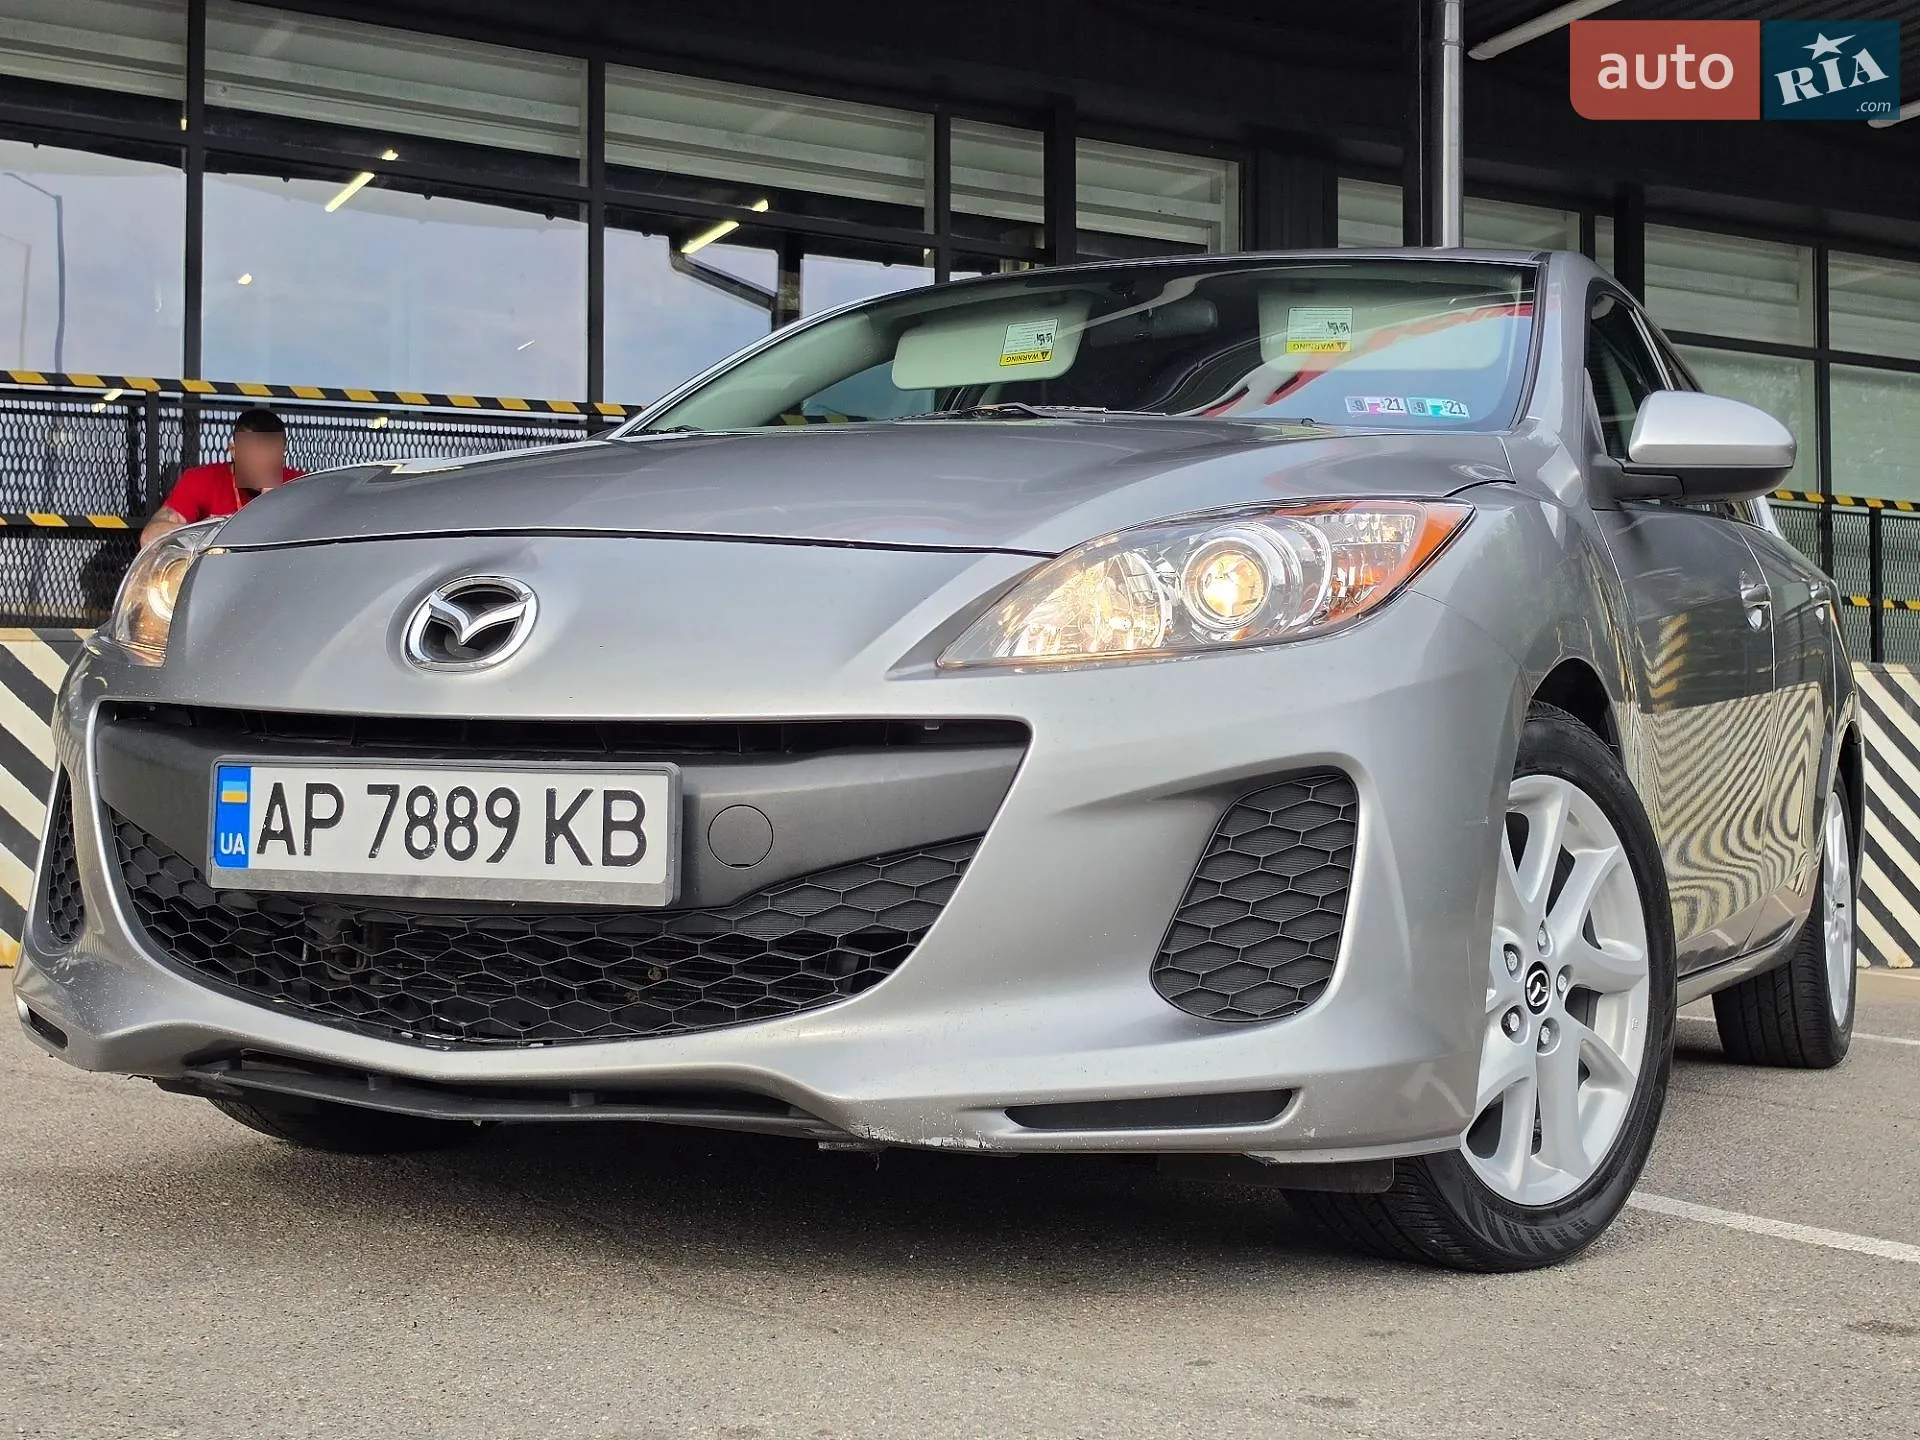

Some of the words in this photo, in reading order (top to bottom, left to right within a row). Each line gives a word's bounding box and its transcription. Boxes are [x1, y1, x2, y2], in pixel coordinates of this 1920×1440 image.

[1005, 353, 1039, 363] WARNING
[1384, 398, 1404, 411] 21
[1446, 400, 1466, 415] 21
[256, 782, 345, 857] AP
[366, 784, 521, 864] 7889
[544, 787, 648, 868] KB
[219, 833, 246, 856] UA
